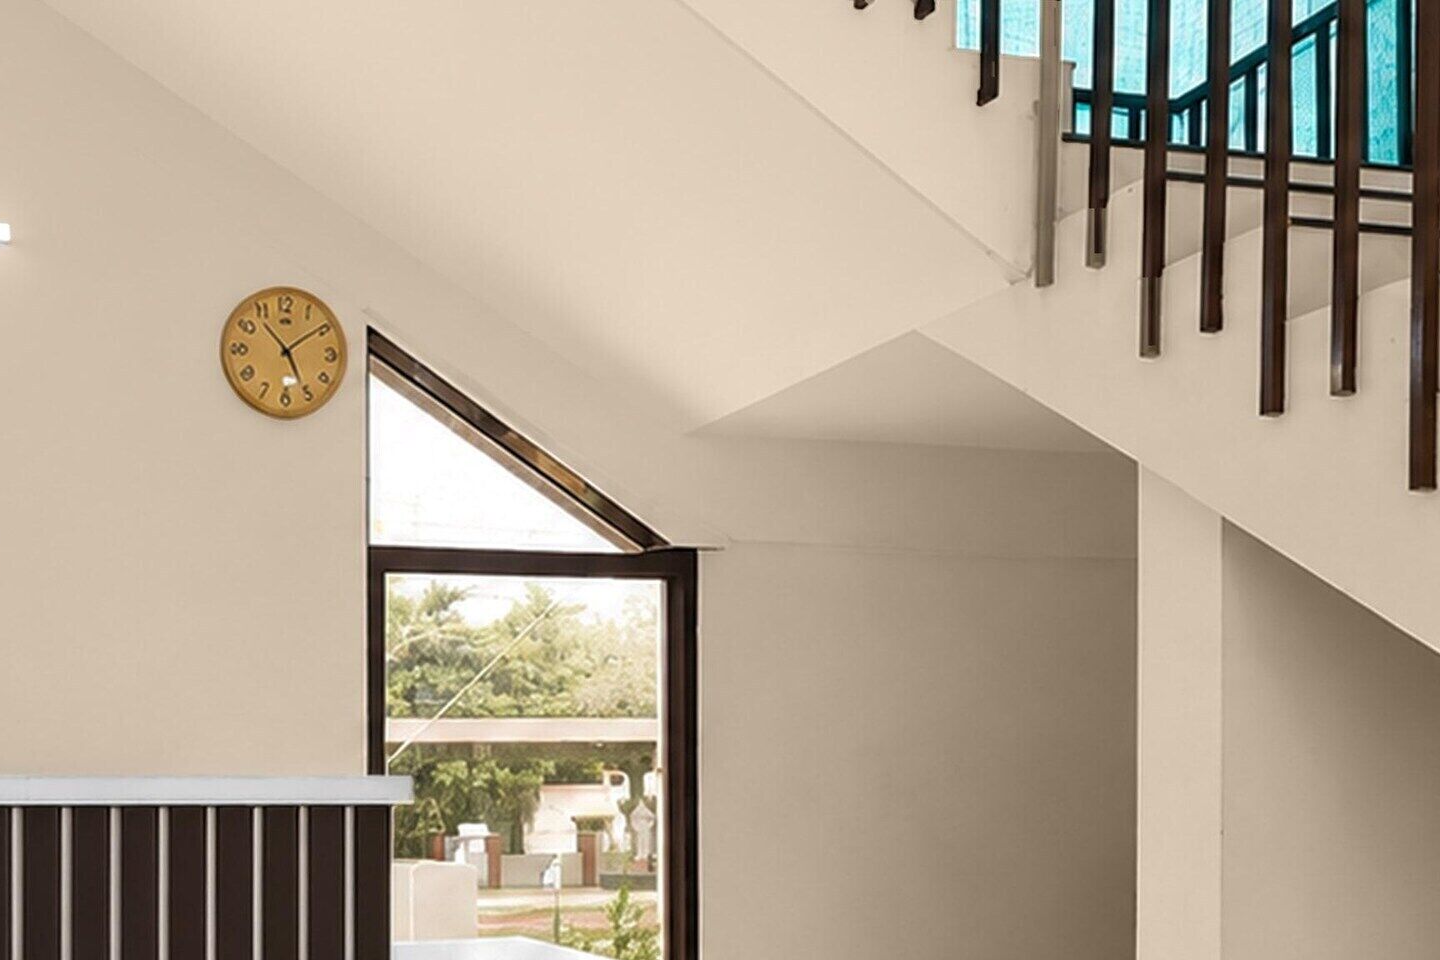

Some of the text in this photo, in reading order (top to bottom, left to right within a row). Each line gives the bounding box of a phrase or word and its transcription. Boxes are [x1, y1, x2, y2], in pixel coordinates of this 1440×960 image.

[255, 301, 269, 318] 11
[278, 296, 293, 313] 12
[305, 304, 312, 320] 1
[324, 346, 338, 363] 3
[259, 381, 270, 399] 7
[280, 387, 291, 406] 6
[302, 385, 313, 401] 5
